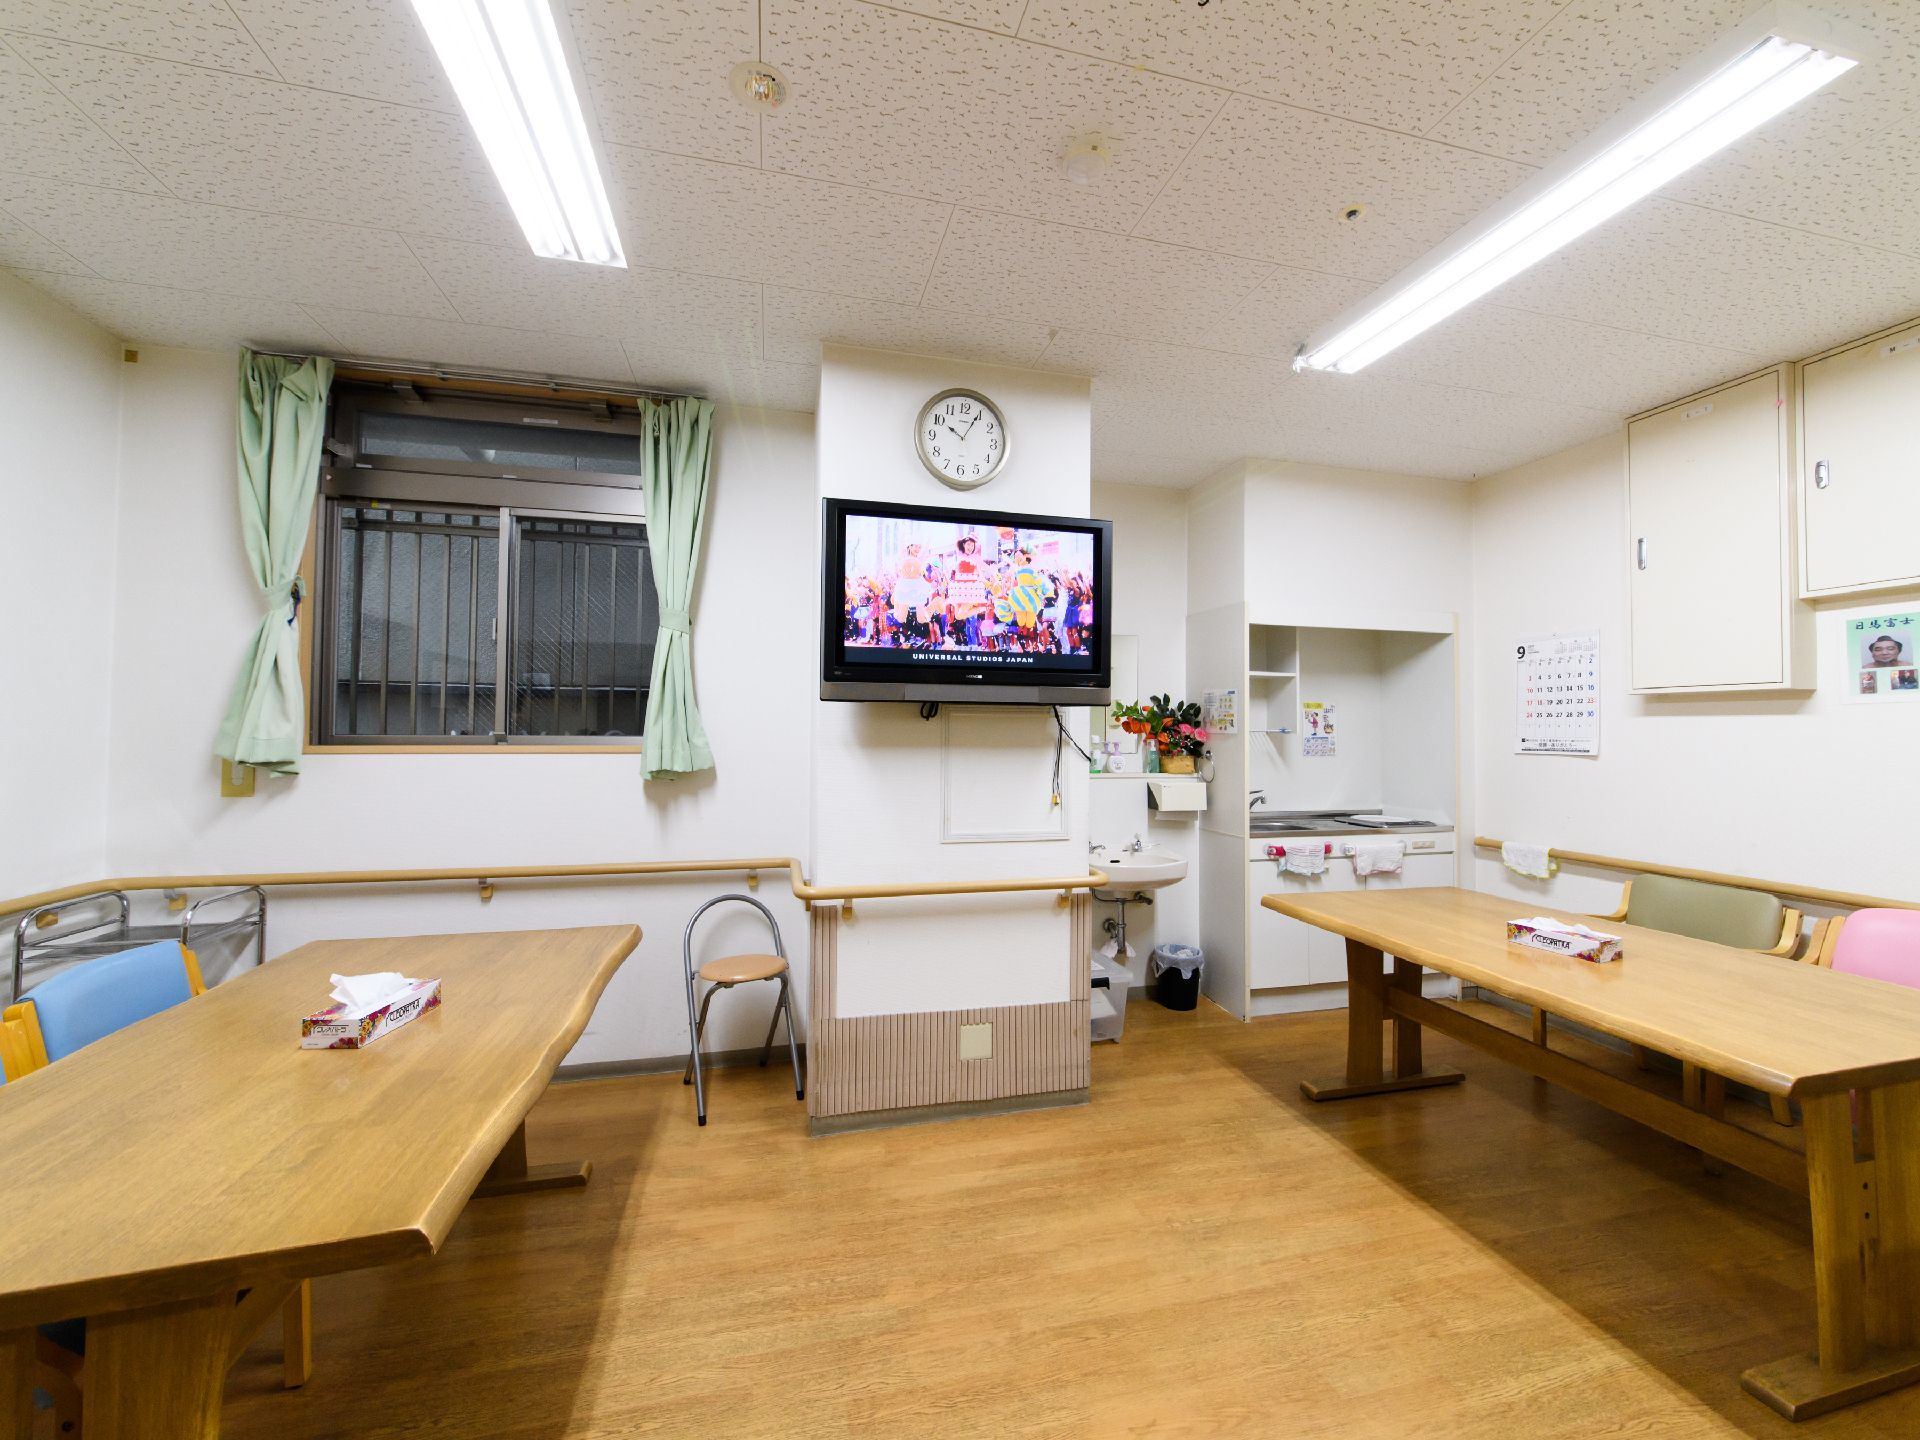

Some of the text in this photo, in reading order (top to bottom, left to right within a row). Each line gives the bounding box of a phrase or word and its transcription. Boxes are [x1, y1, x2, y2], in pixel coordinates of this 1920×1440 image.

[946, 404, 954, 415] 11
[960, 403, 970, 414] 12
[934, 414, 945, 426] 10
[986, 422, 993, 434] 2
[929, 430, 936, 440] 9
[990, 439, 997, 450] 3
[933, 446, 940, 457] 8
[944, 459, 950, 469] 7
[984, 454, 990, 463] 4
[957, 465, 964, 475] 6
[973, 464, 979, 474] 5
[1856, 618, 1914, 630] 日馬富士
[1517, 646, 1526, 660] 9
